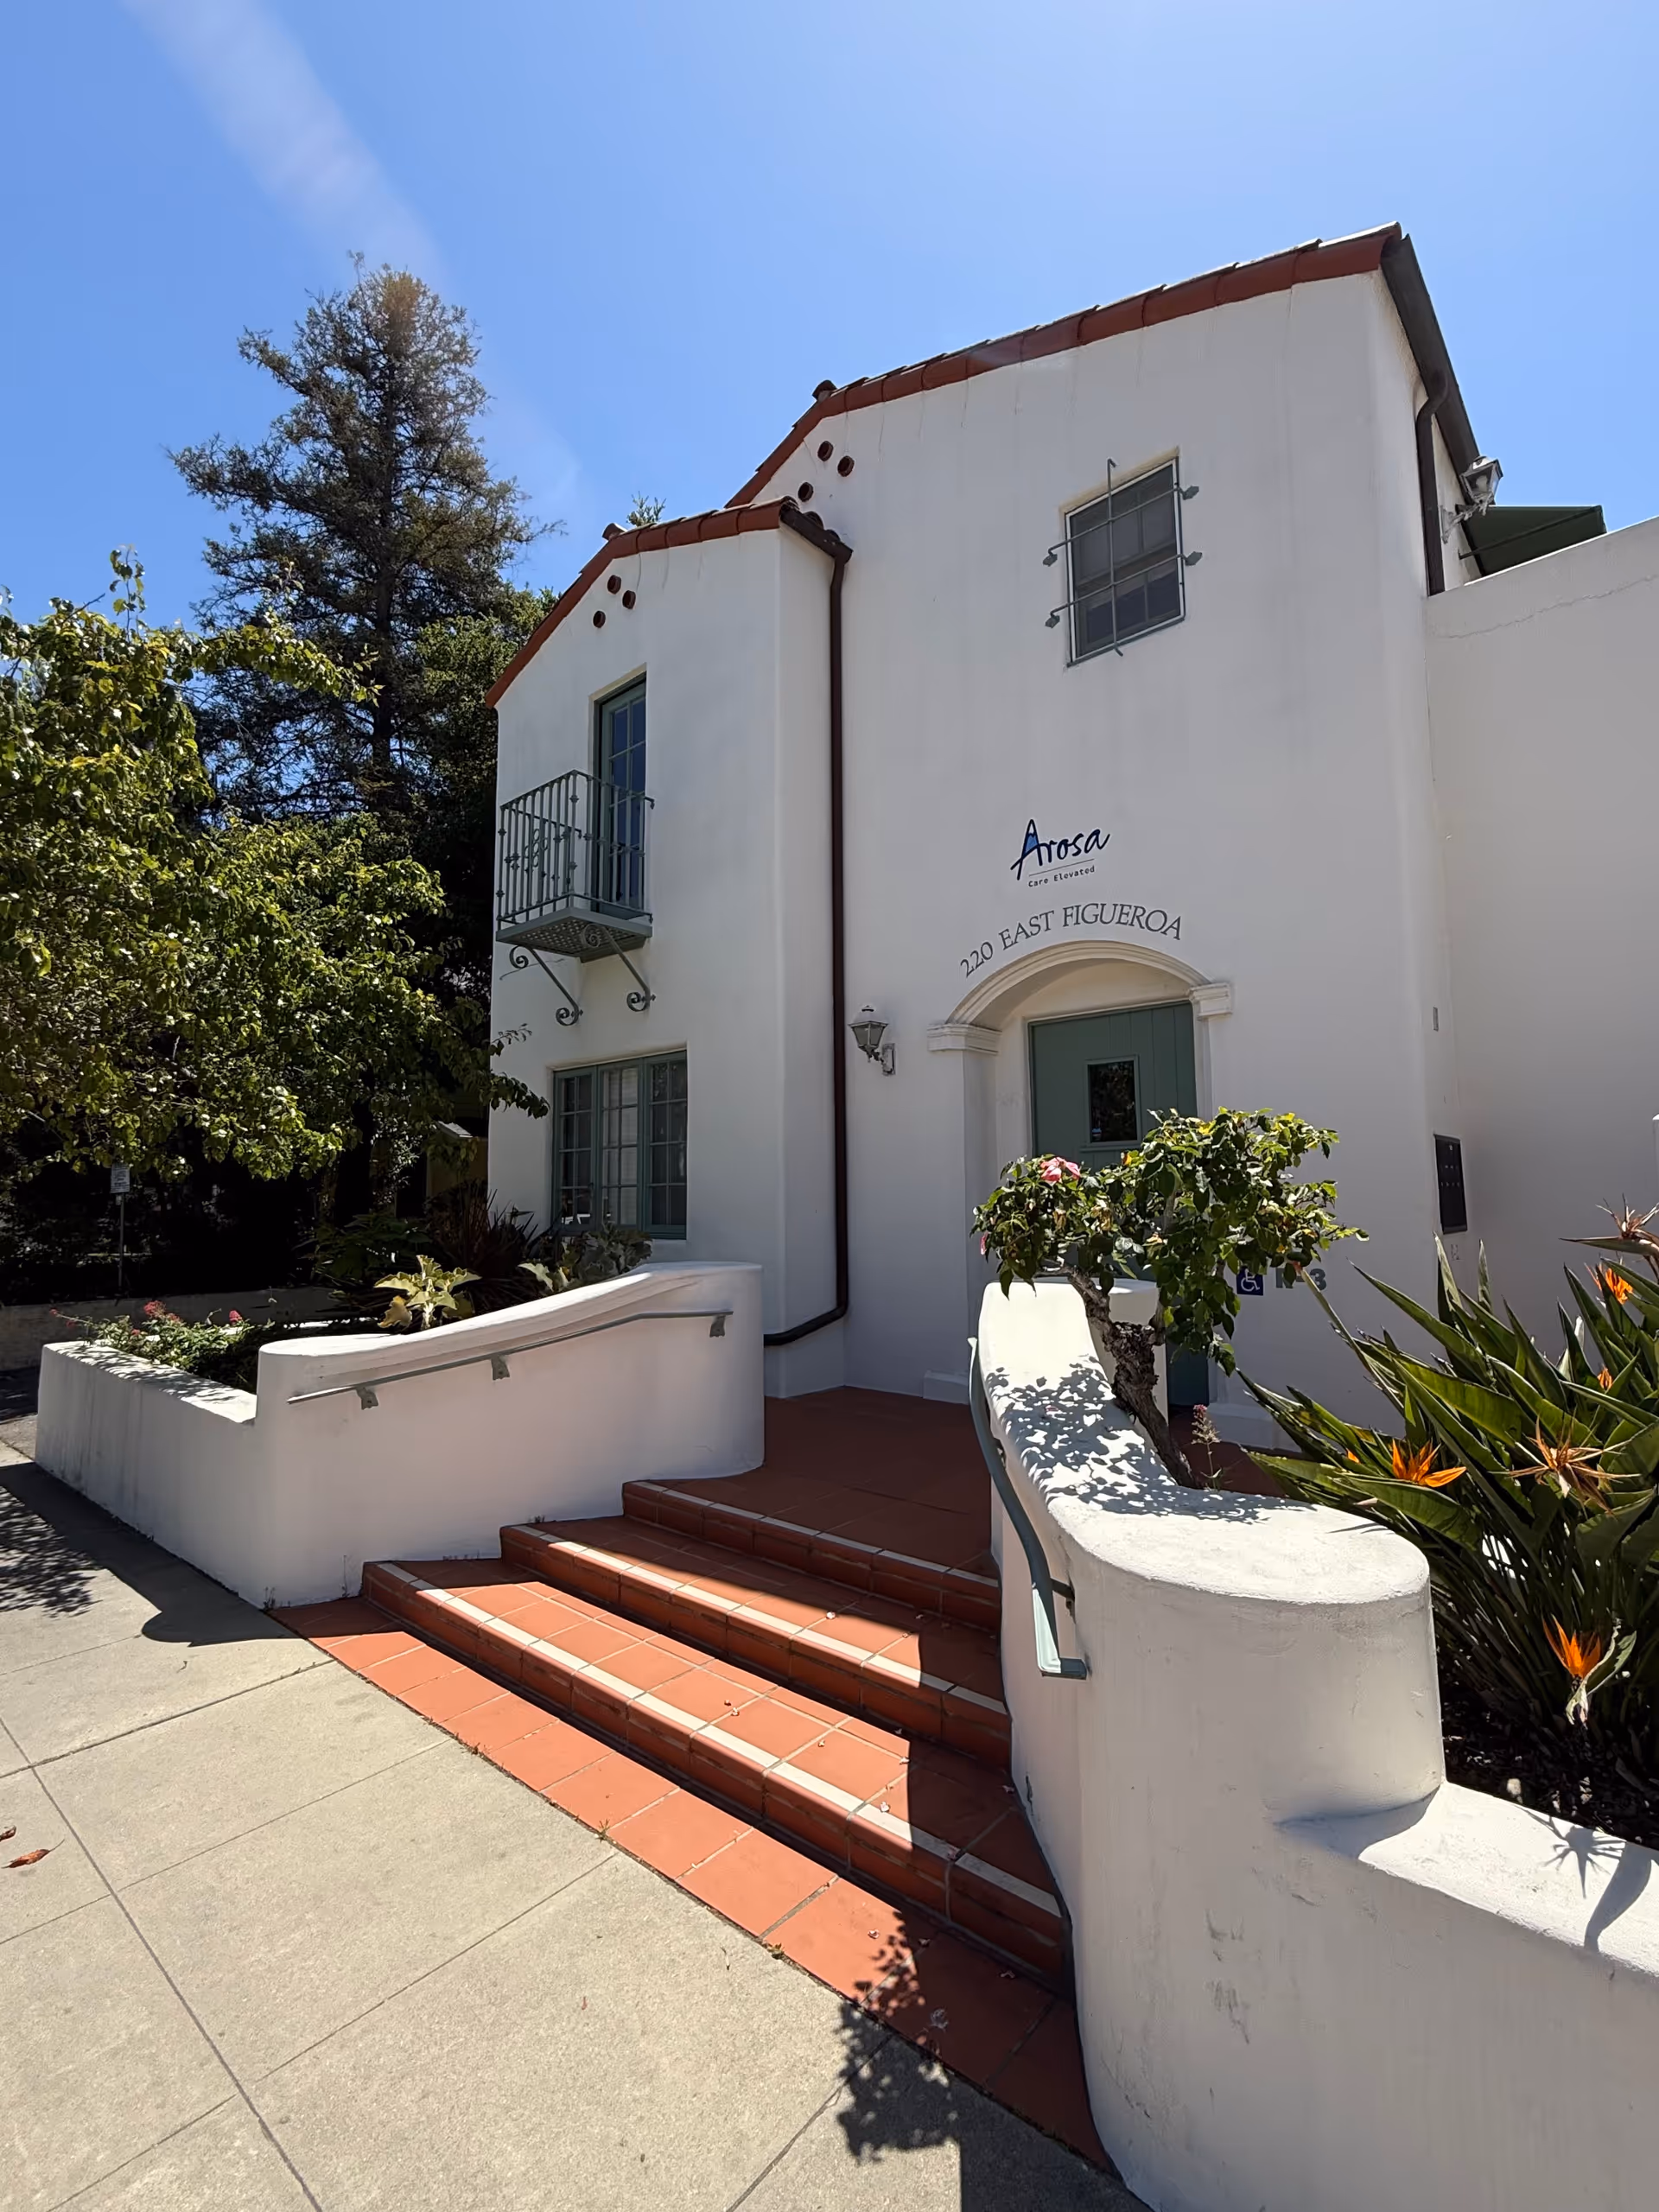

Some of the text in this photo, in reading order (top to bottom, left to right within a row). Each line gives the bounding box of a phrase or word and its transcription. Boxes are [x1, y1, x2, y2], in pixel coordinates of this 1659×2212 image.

[1010, 818, 1111, 880] Arosa
[1028, 865, 1096, 887] Care Elevated
[959, 902, 1183, 978] 220 EAST FIGUEROA
